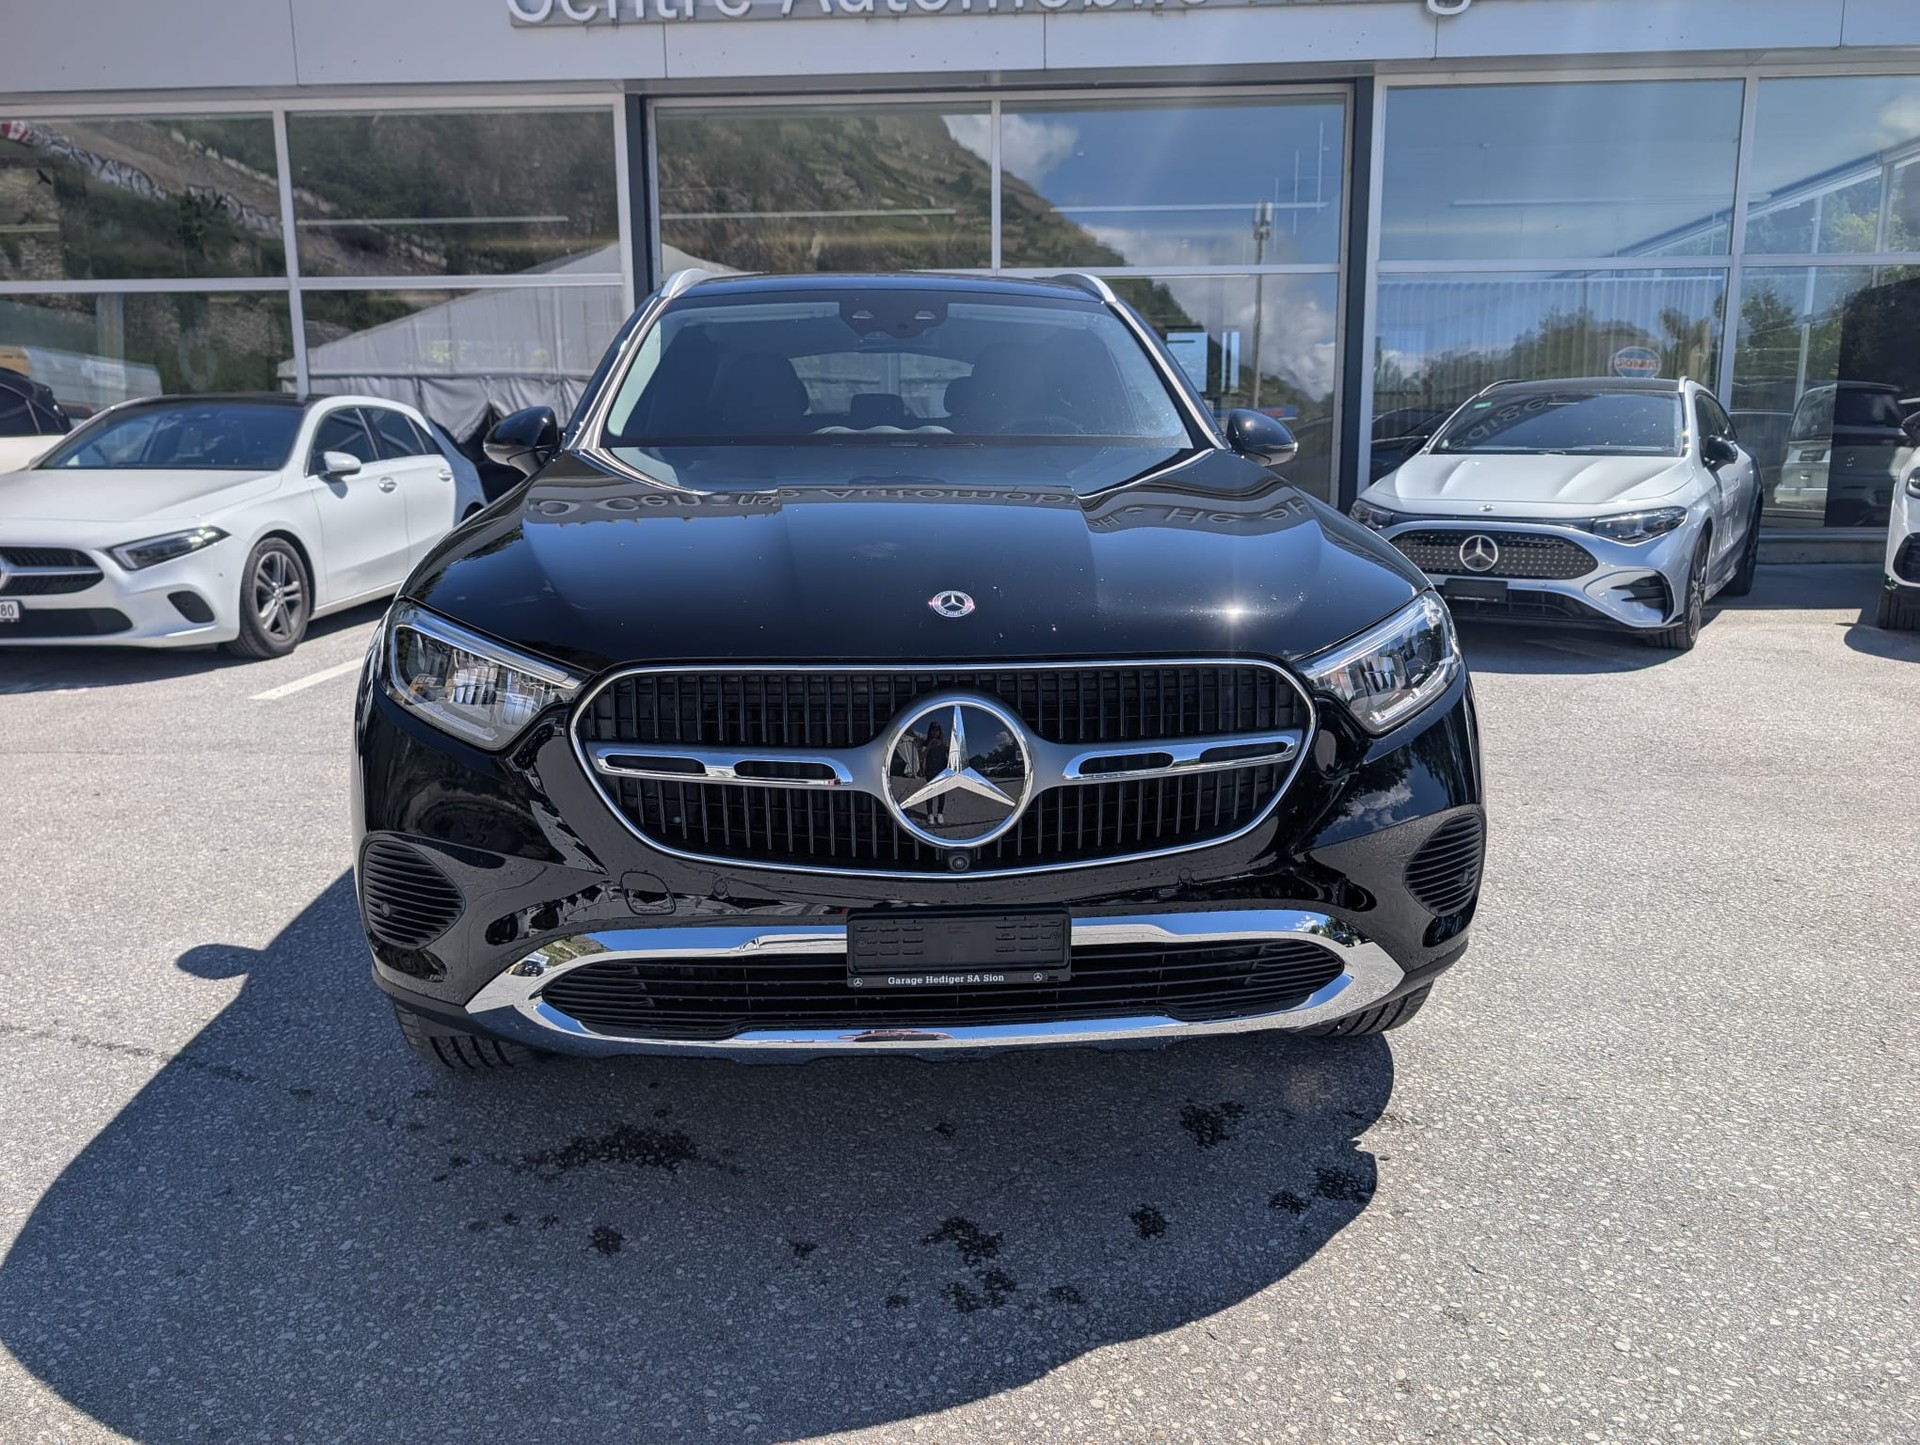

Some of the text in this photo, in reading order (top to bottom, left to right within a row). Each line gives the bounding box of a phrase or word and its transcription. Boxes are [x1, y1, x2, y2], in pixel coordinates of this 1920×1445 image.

[887, 974, 1004, 985] Garage Hediger SA Sion
